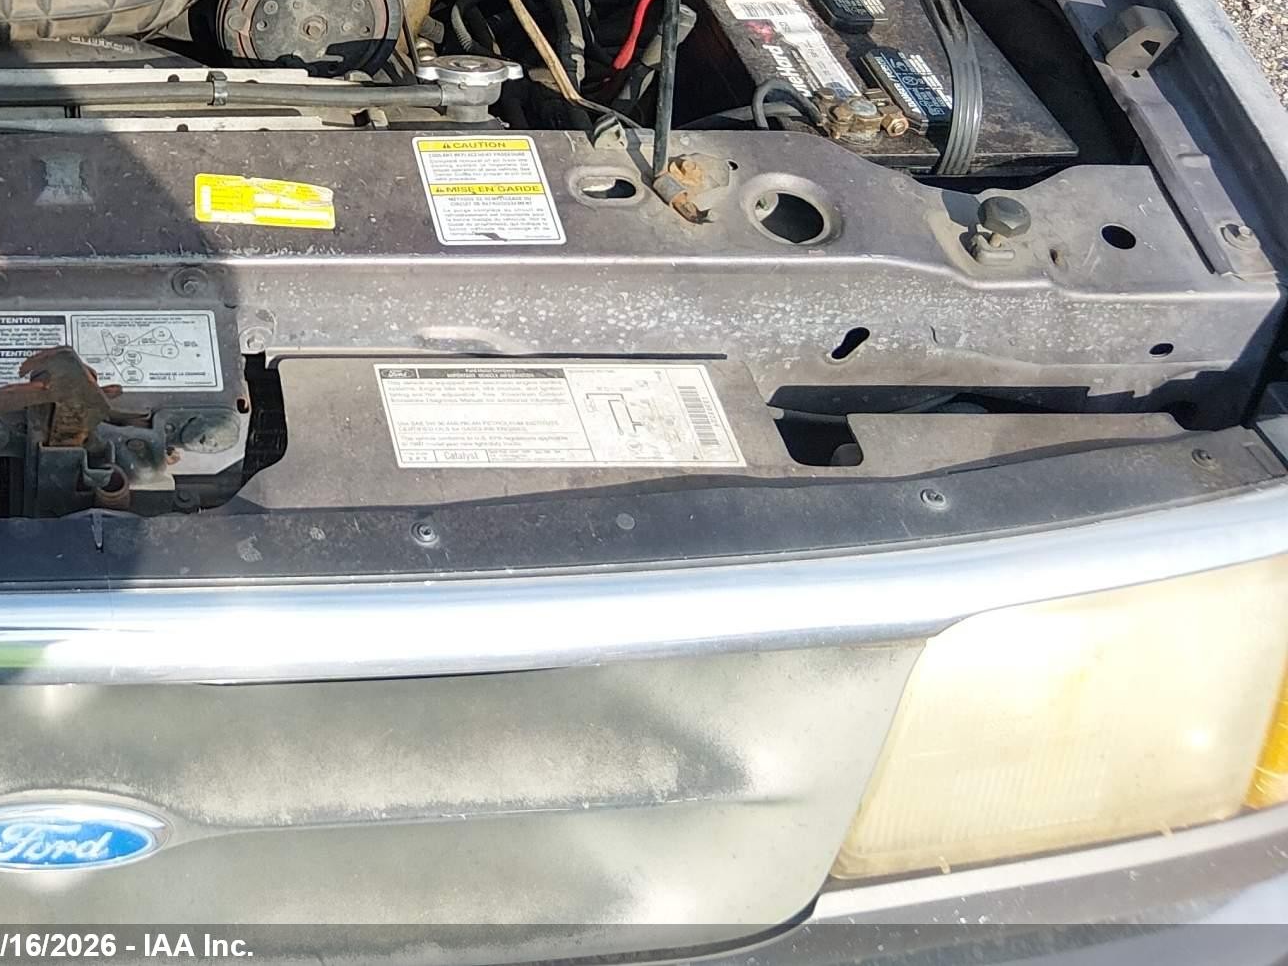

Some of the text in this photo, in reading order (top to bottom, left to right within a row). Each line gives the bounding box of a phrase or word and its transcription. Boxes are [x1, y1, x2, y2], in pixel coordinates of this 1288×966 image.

[452, 141, 507, 150] CAUTION
[446, 184, 541, 193] MISE EN GARDE
